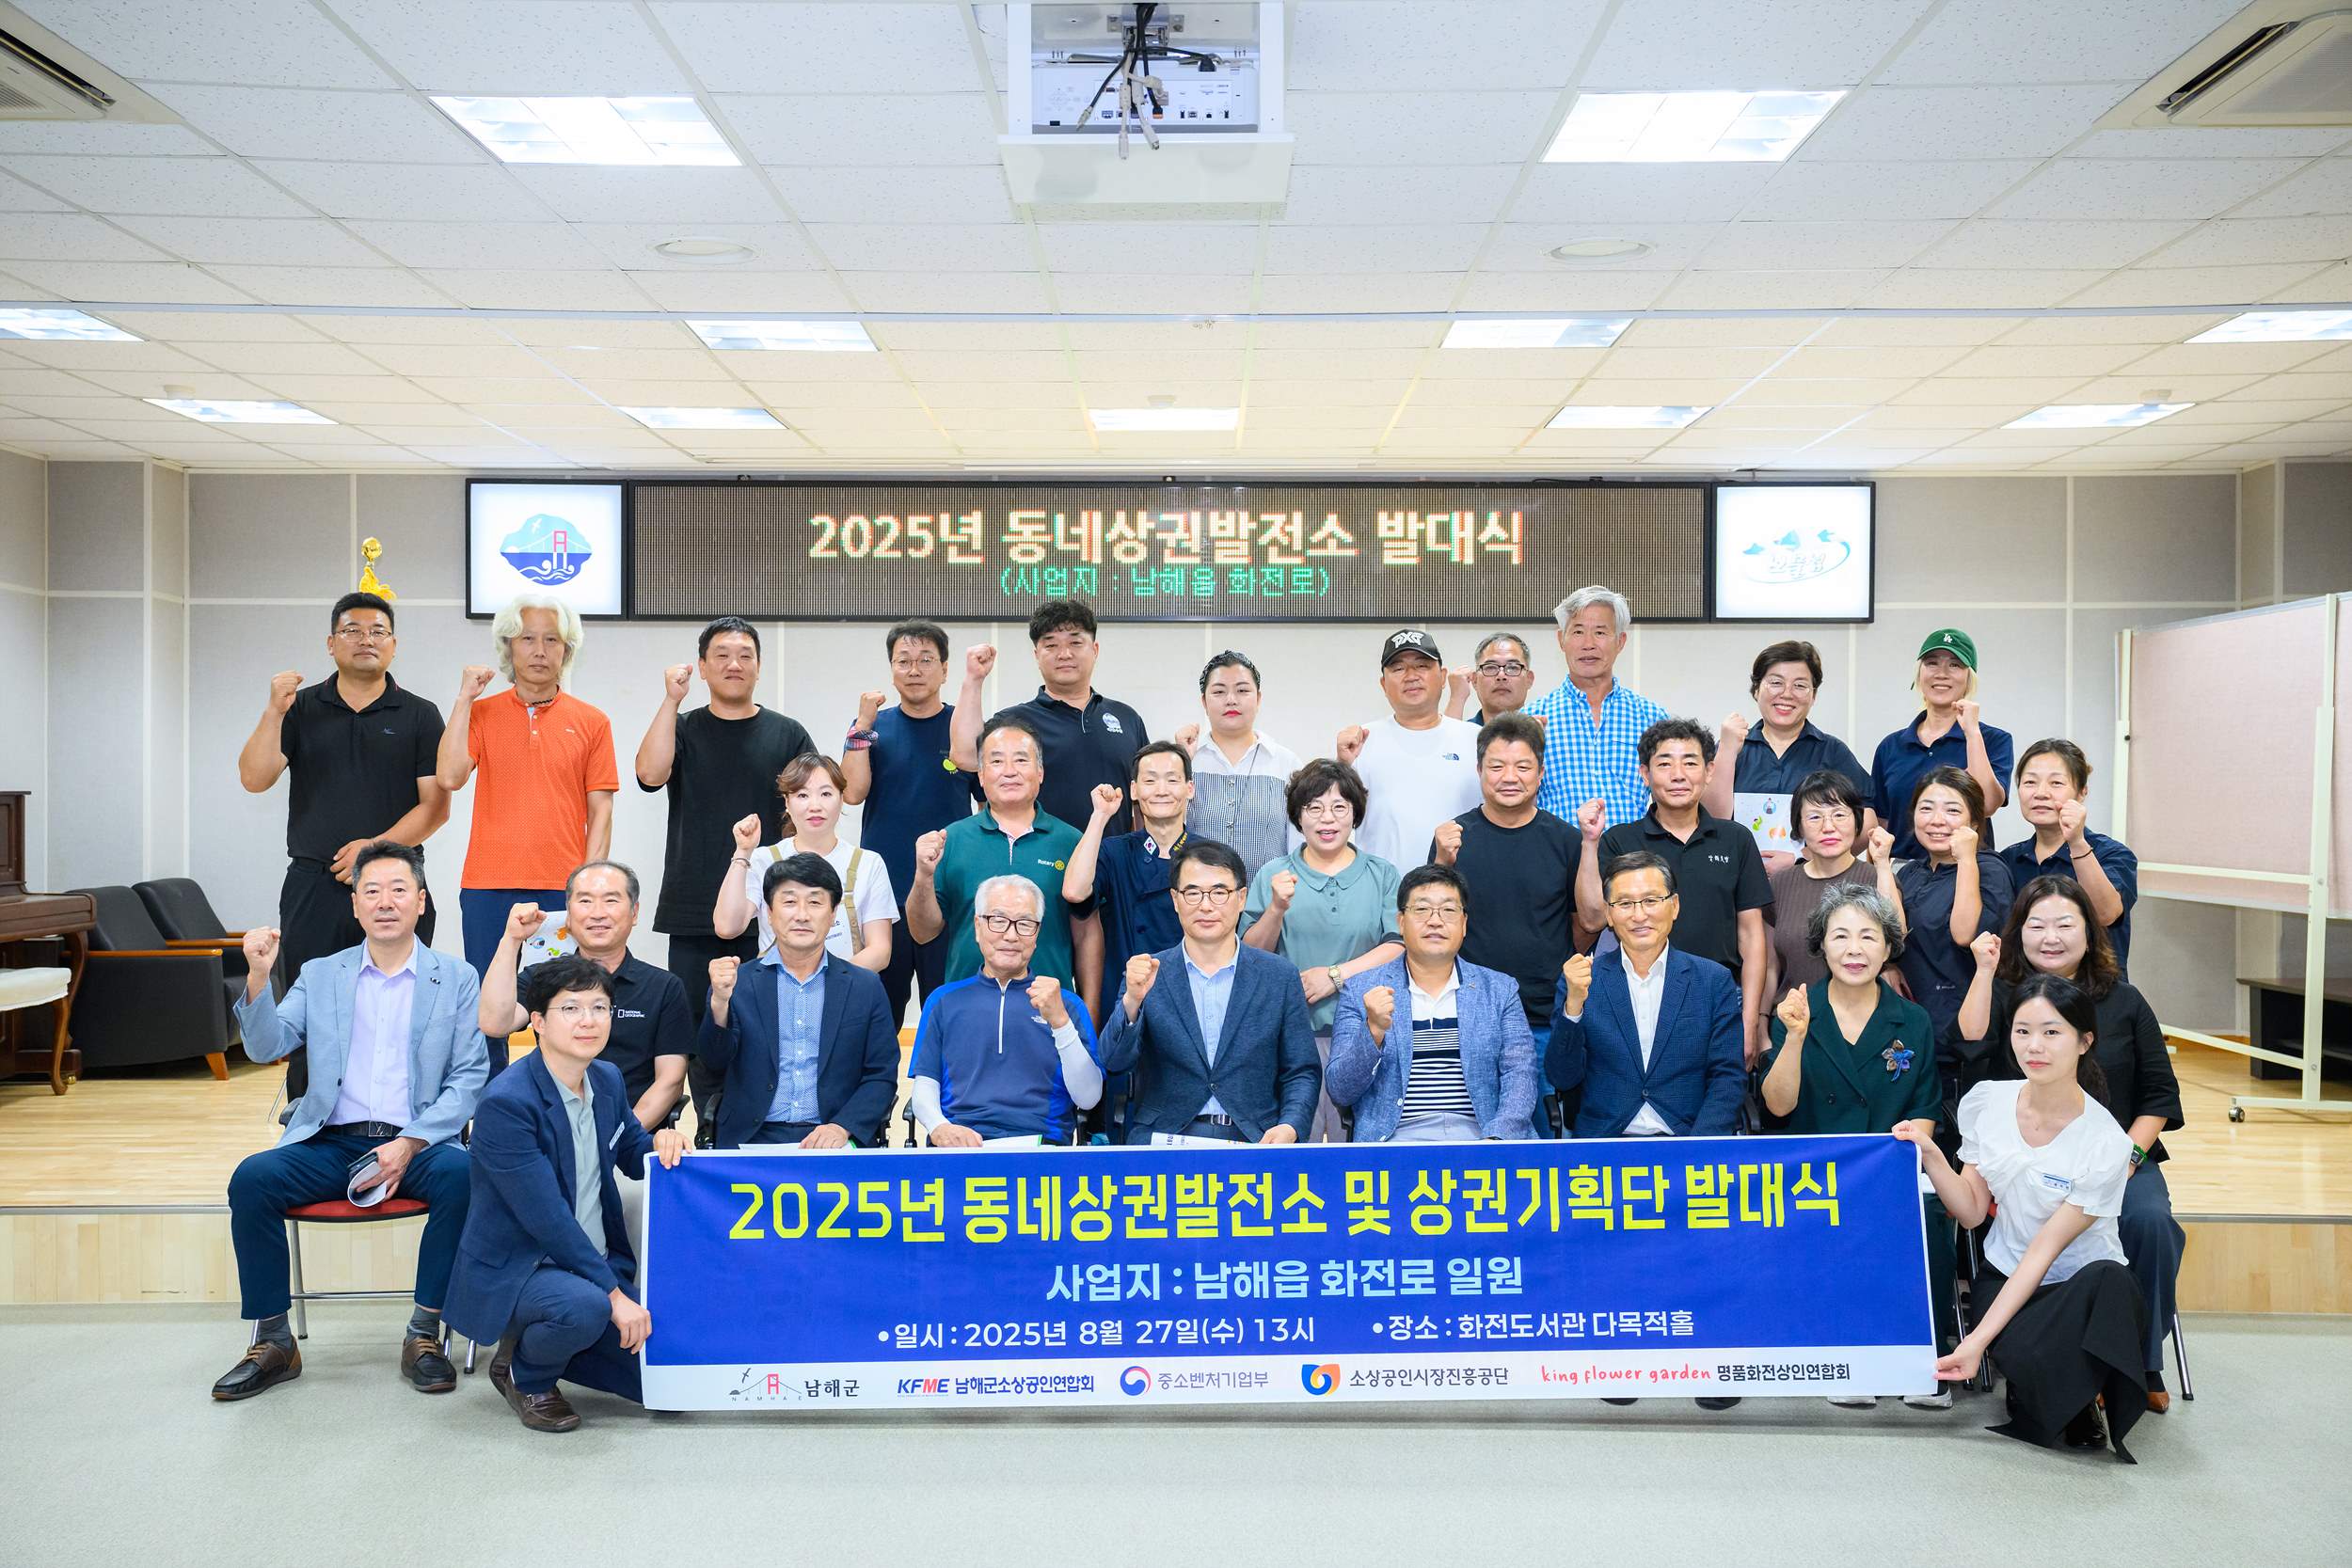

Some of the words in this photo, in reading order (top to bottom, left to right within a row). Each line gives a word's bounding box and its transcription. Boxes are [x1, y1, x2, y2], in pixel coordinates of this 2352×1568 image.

[808, 510, 985, 564] 2025년
[1000, 509, 1360, 564] 동네상권발전소
[1376, 511, 1524, 564] 발대식
[1000, 566, 1098, 596] (사업지
[1132, 566, 1216, 596] 남해읍
[1227, 566, 1329, 597] 화전로)
[729, 1178, 946, 1243] 2025년
[962, 1172, 1327, 1243] 동네상권발전소
[1344, 1170, 1391, 1236] 및
[1407, 1164, 1670, 1236] 상권기획단
[1685, 1162, 1840, 1229] 발대식
[1046, 1262, 1161, 1302] 사업지
[1194, 1259, 1310, 1300] 남해읍
[1319, 1258, 1437, 1298] 화전로
[1447, 1256, 1523, 1295] 일원
[963, 1321, 1067, 1347] 2025년
[1079, 1320, 1123, 1346] 8월
[1136, 1317, 1244, 1345] 27일(수)
[1254, 1316, 1315, 1342] 13시
[1457, 1312, 1587, 1339] 화전도서관
[1592, 1309, 1694, 1338] 다목적홀
[804, 1379, 861, 1398] 남해군
[897, 1378, 950, 1394] KFME
[955, 1375, 1094, 1395] 남해군소상공인연합회
[1157, 1371, 1269, 1390] 중소벤처기업부
[1349, 1367, 1509, 1388] 소상공인시장진흥공단
[1541, 1365, 1579, 1386] king
[1584, 1365, 1643, 1385] flower
[1648, 1363, 1711, 1384] garden
[1716, 1362, 1851, 1383] 명품화전상인연합회
